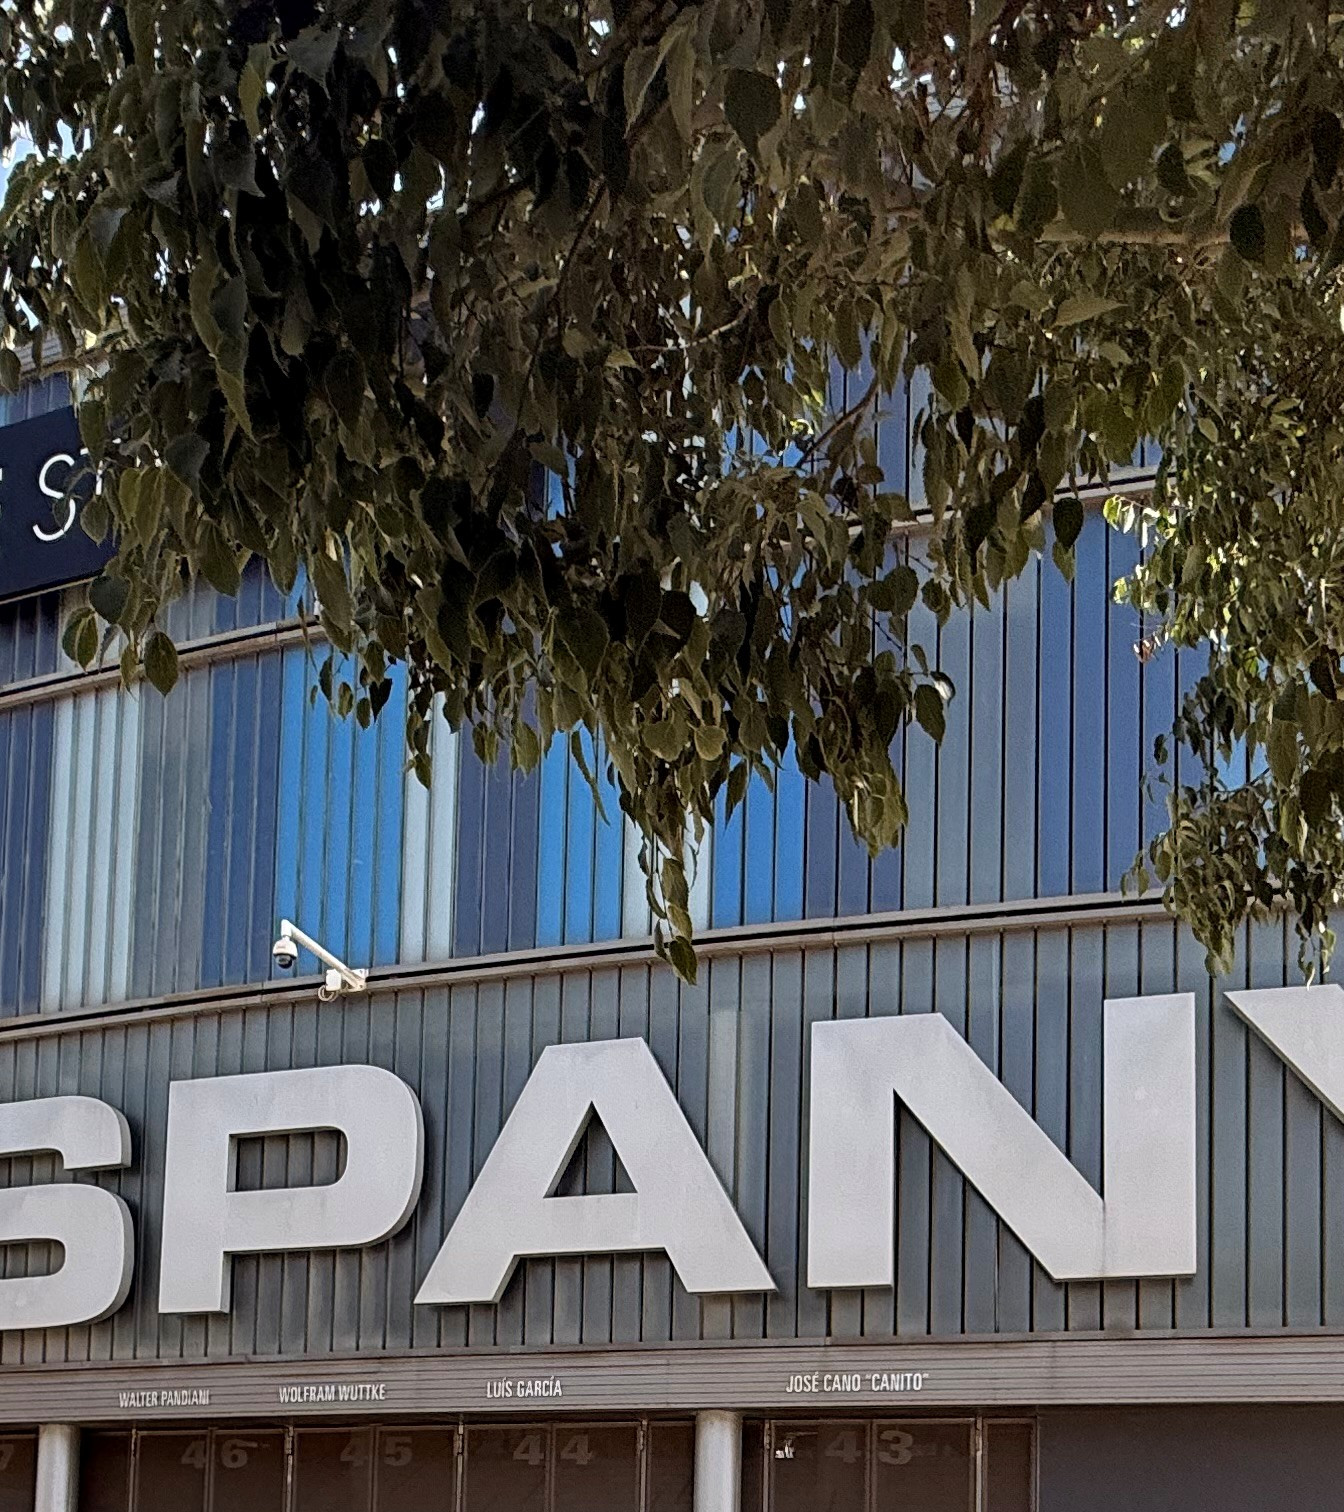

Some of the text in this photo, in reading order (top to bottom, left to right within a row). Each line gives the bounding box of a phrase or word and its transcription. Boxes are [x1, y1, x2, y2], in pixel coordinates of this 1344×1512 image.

[486, 1375, 562, 1398] LUÍS GARCÍA
[785, 1371, 819, 1393] JOSÉ
[823, 1373, 861, 1393] CANO
[119, 1389, 210, 1409] WALTER PANDIANI
[279, 1383, 386, 1404] WOLFRAM WUTTKE
